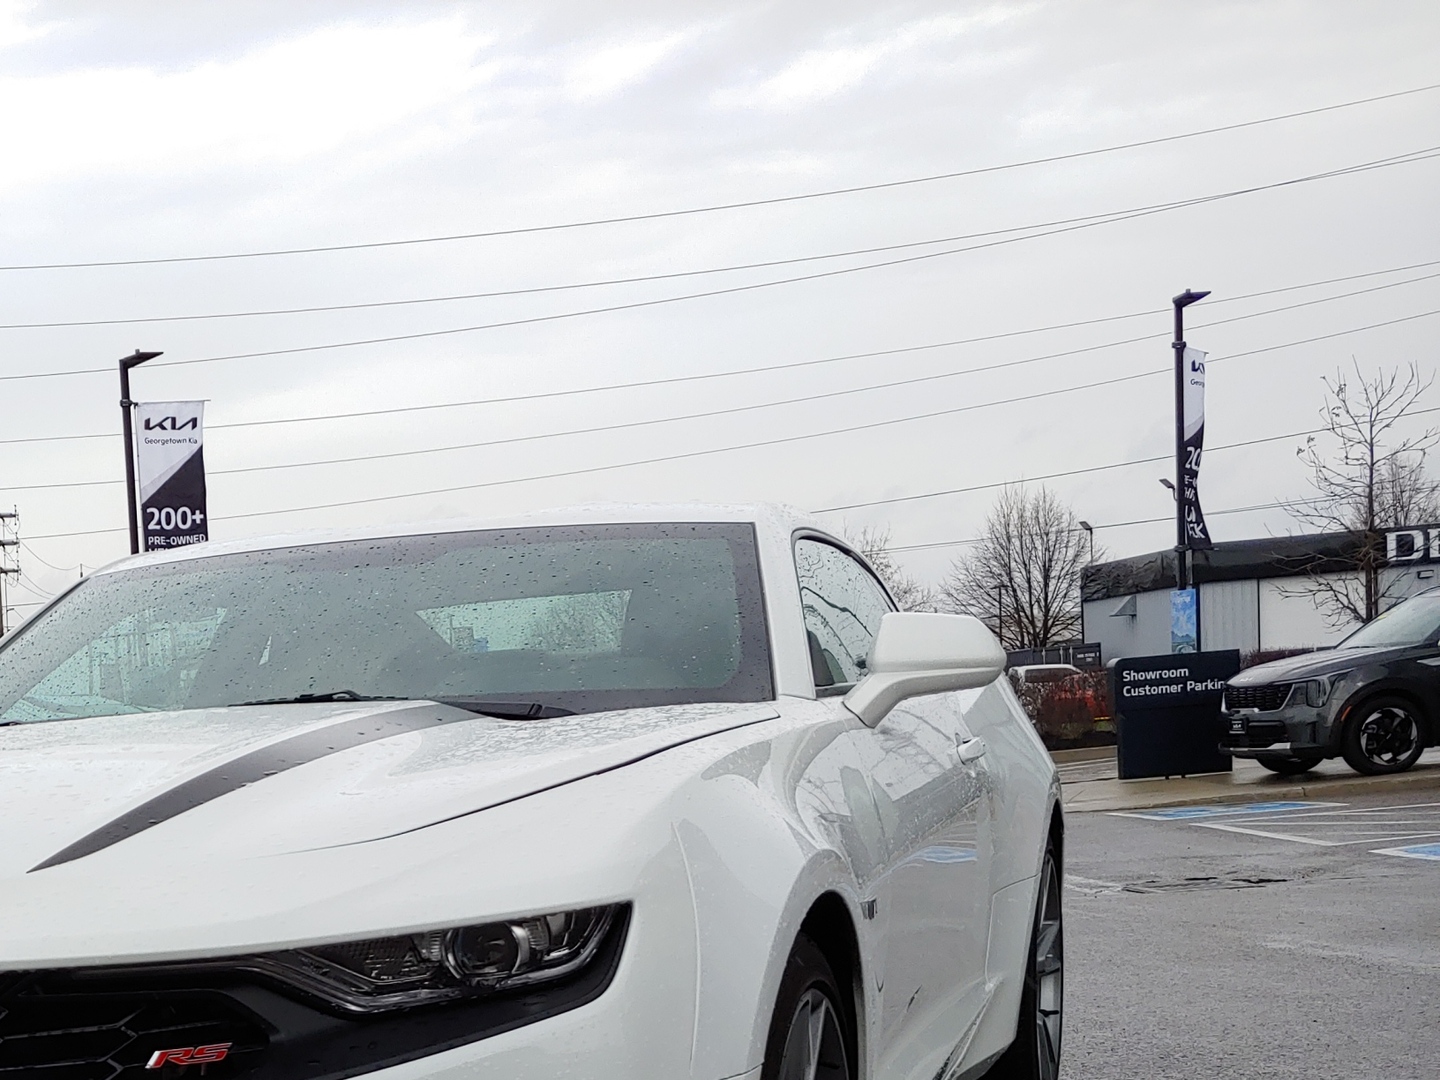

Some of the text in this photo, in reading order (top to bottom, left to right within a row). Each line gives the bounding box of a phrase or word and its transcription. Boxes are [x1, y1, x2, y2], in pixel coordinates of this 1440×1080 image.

[143, 416, 197, 431] KIA
[144, 437, 187, 446] Georgetown
[146, 506, 204, 530] 200+
[148, 534, 206, 545] PRE-OWNED
[1122, 668, 1189, 681] Showroom
[1122, 679, 1226, 697] Customer Parkin
[145, 1042, 233, 1068] RS
